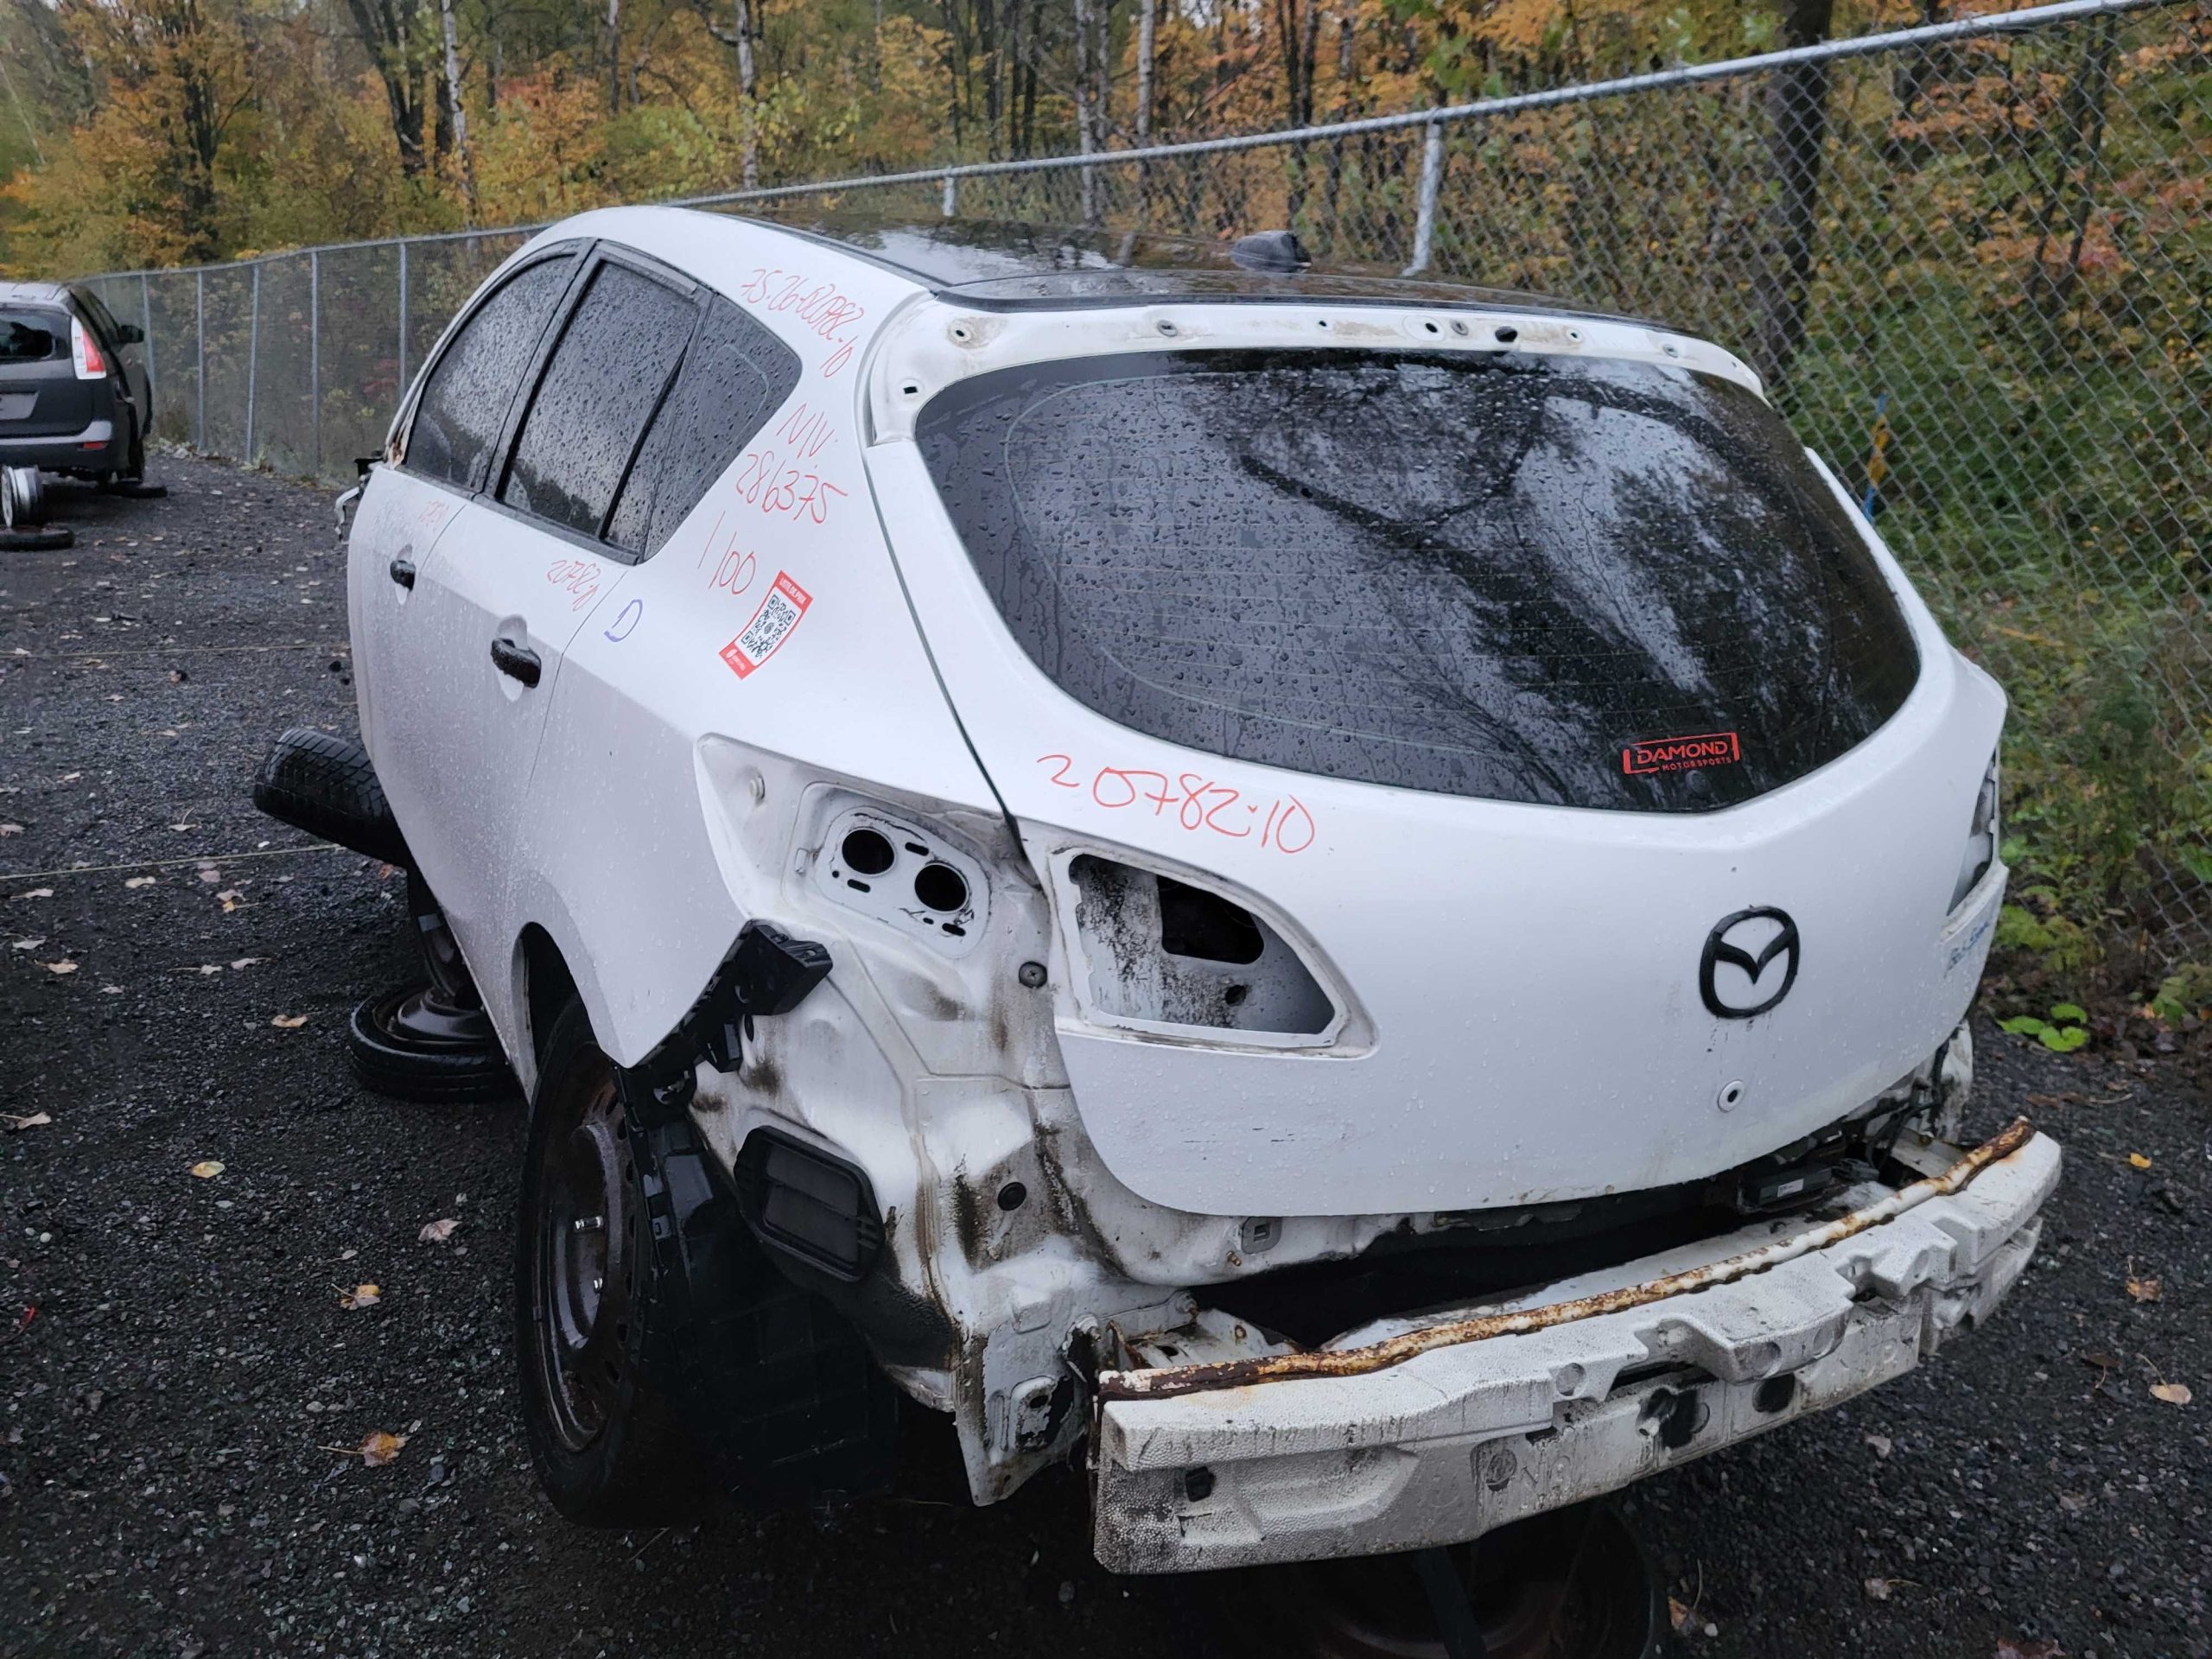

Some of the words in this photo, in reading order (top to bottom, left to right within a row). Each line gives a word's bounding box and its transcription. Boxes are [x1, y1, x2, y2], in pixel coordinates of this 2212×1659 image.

[736, 451, 848, 524] 286375
[1637, 741, 1728, 764] DAMOND
[1662, 757, 1732, 771] MOTORSPORTS
